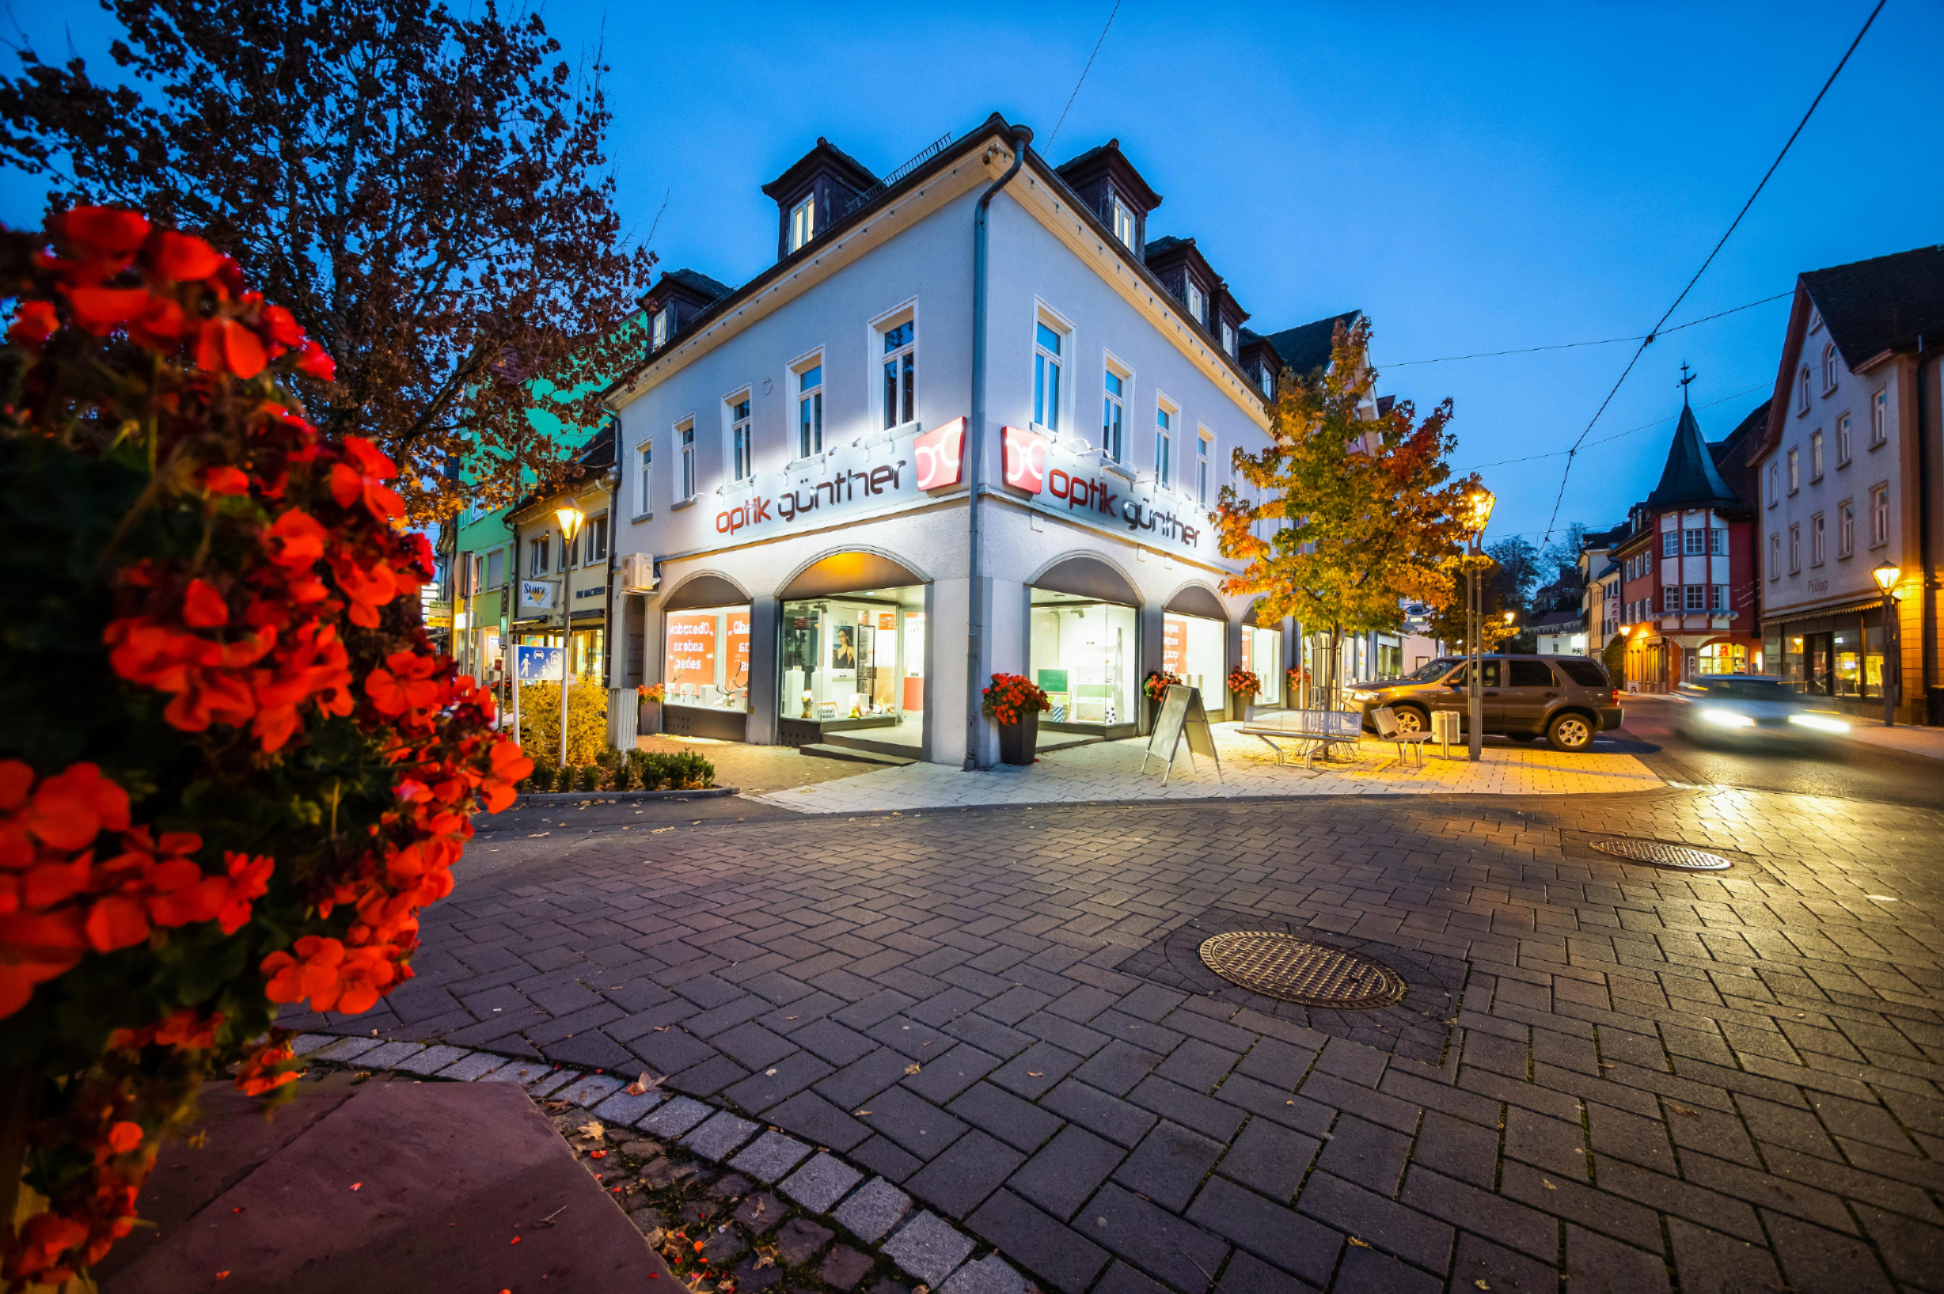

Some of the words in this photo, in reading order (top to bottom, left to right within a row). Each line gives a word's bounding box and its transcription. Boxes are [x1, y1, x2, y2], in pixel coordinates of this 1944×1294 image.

[716, 496, 771, 535] optik
[777, 460, 907, 522] günther
[1049, 468, 1118, 518] optik
[1122, 497, 1200, 548] günther
